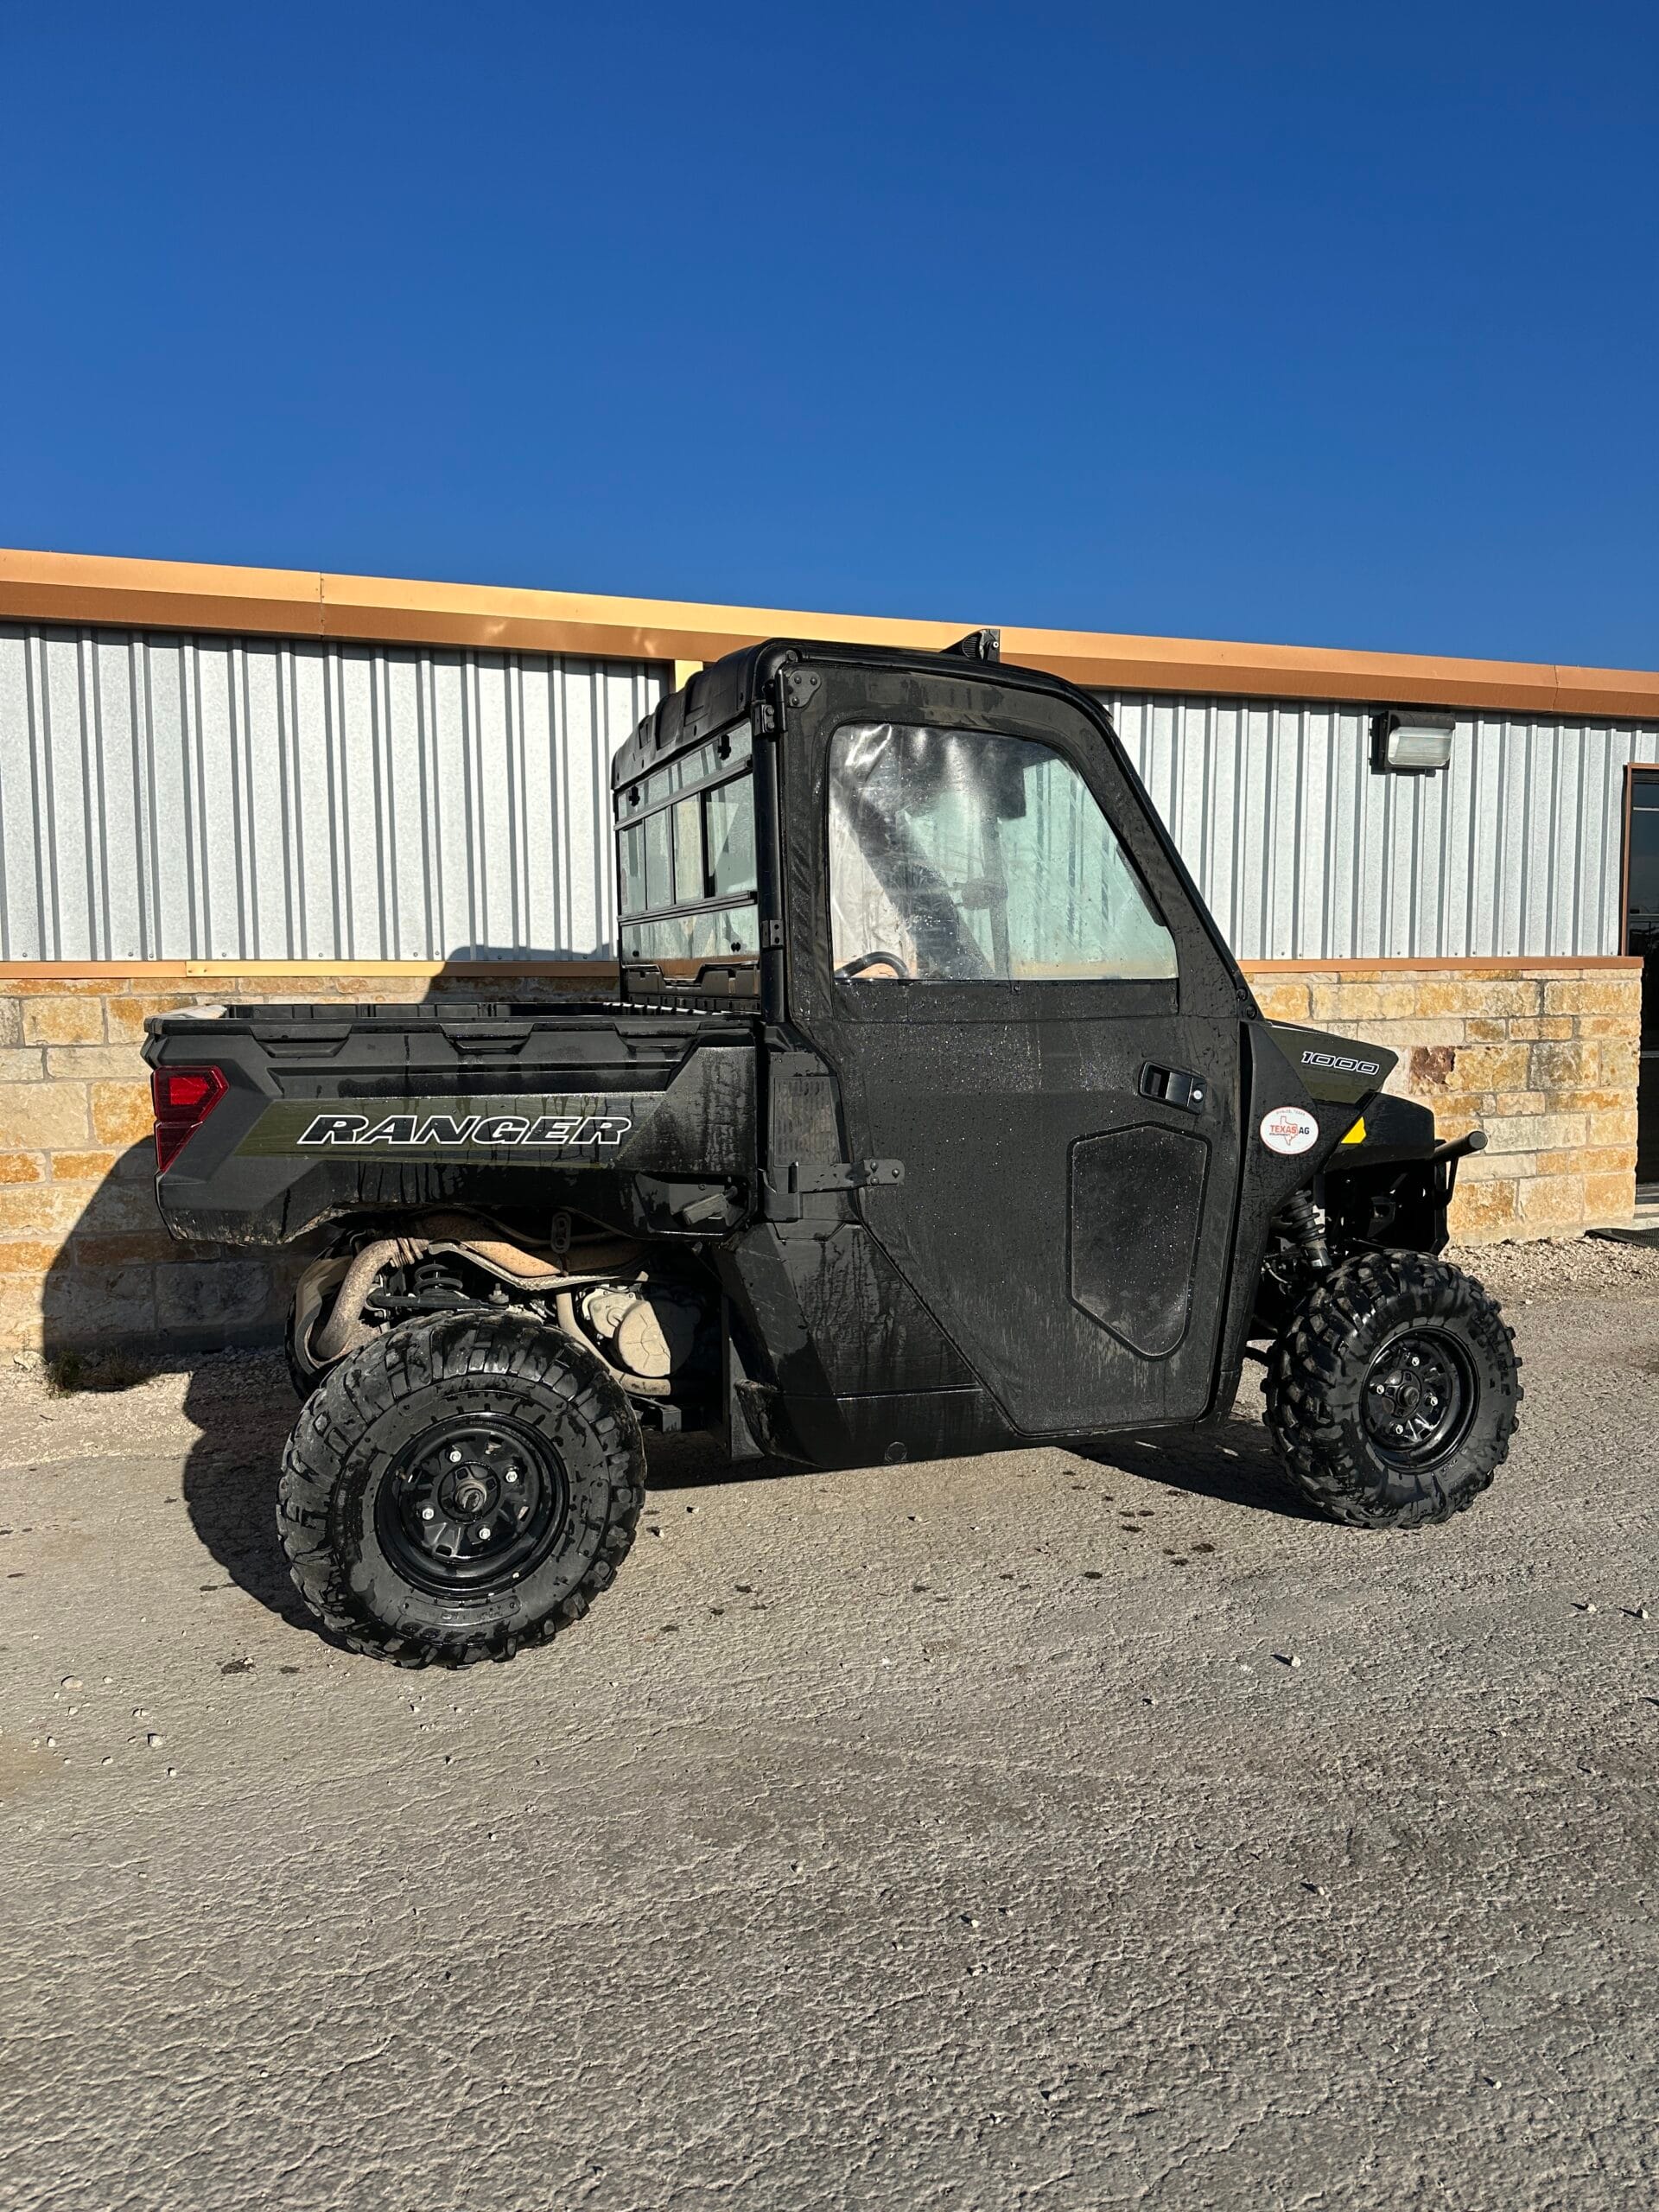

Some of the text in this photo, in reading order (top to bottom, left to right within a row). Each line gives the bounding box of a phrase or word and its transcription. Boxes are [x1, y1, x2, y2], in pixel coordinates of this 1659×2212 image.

[1301, 1051, 1380, 1076] 1000
[297, 1115, 632, 1145] RANGER
[1270, 1125, 1297, 1134] TEXAS
